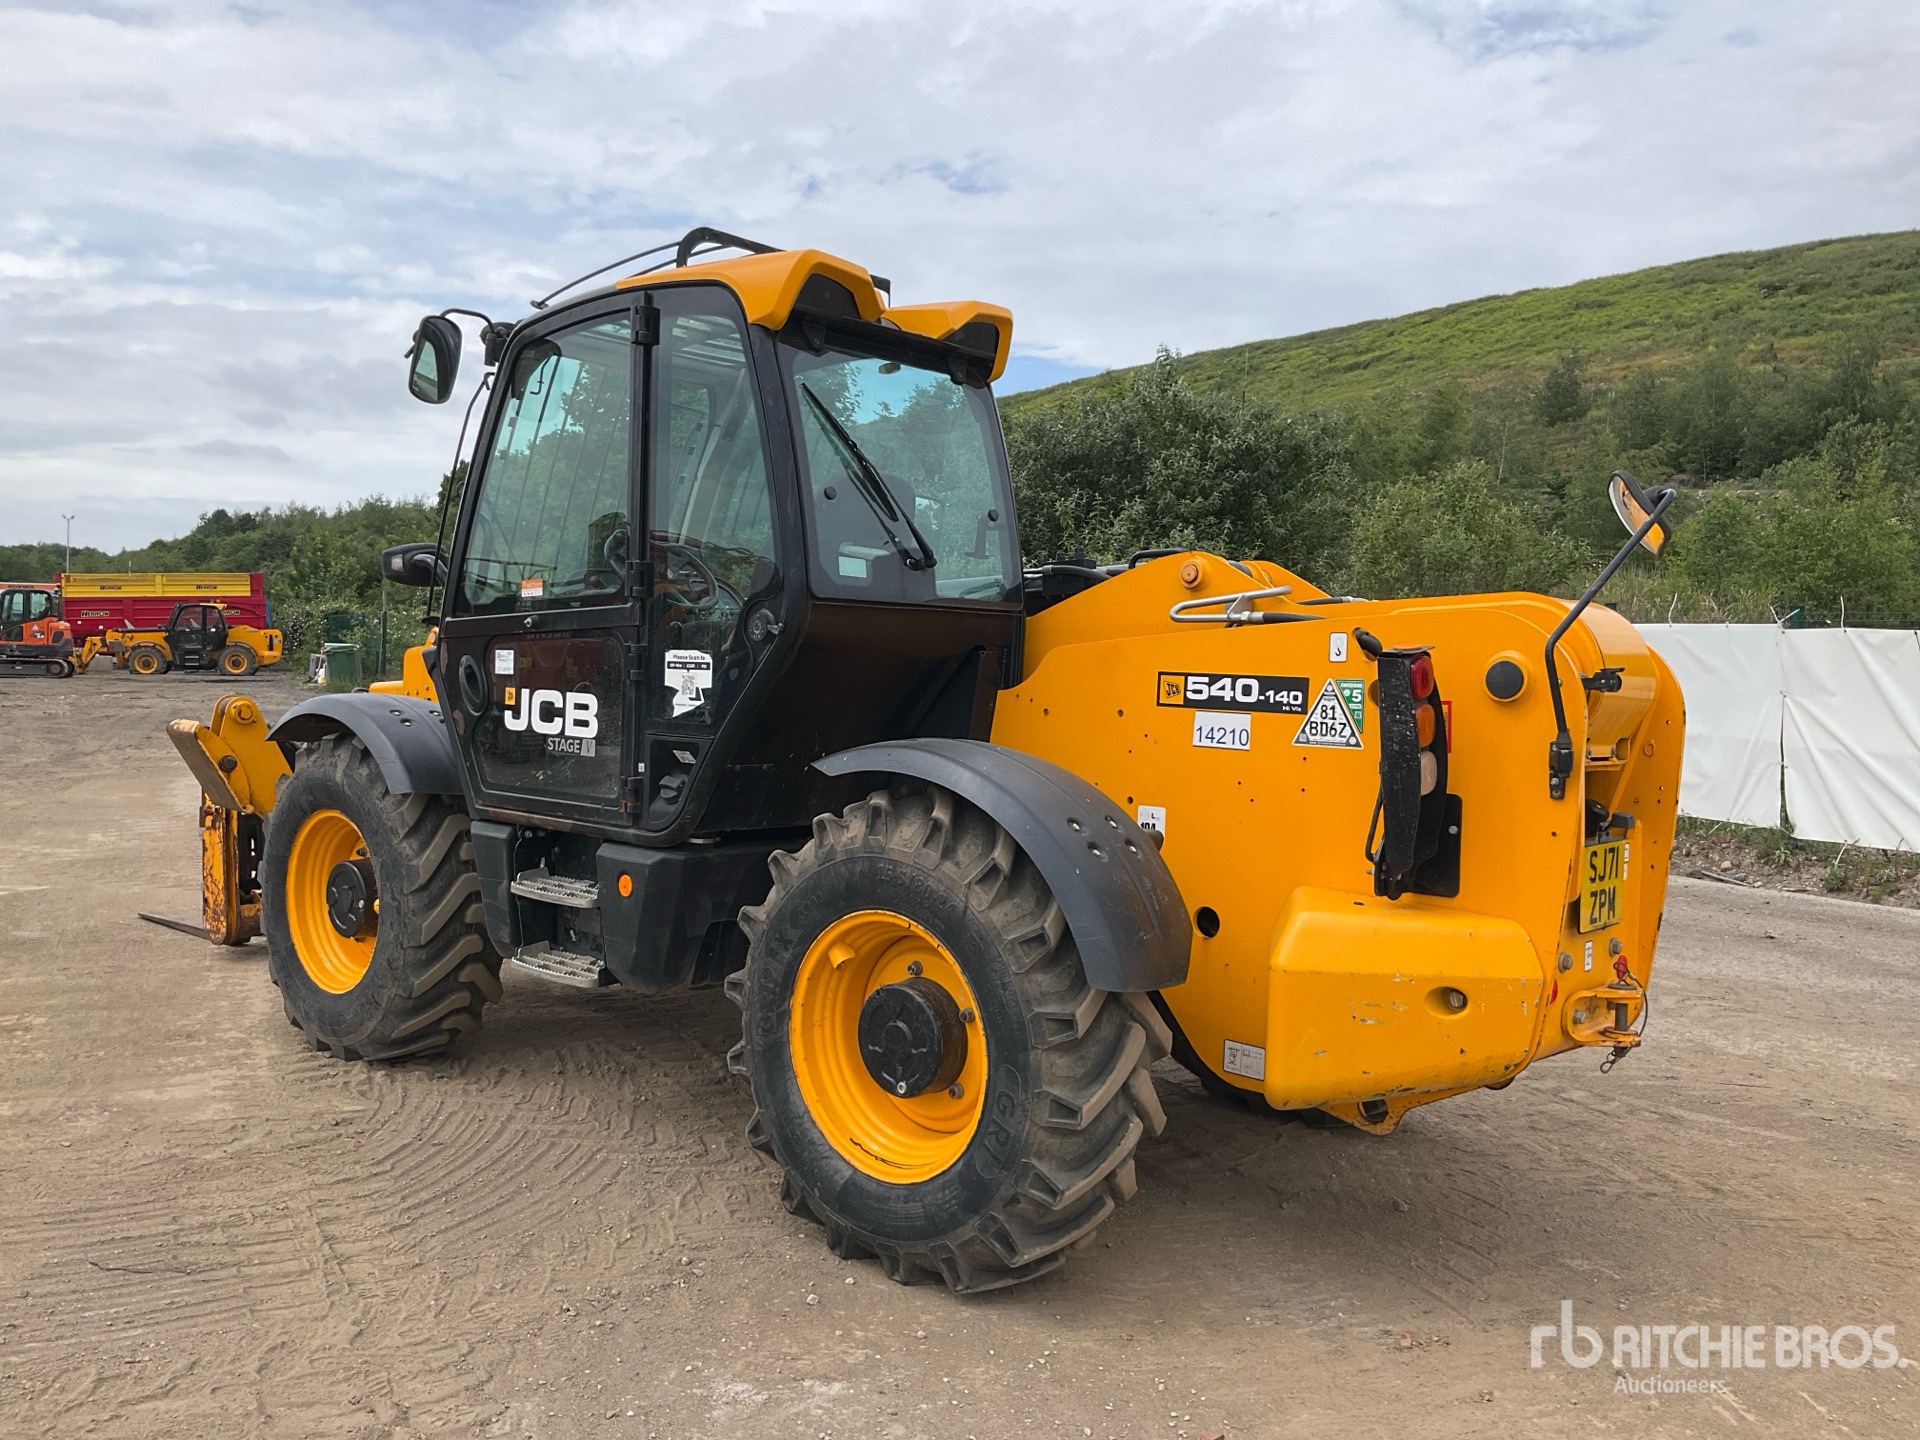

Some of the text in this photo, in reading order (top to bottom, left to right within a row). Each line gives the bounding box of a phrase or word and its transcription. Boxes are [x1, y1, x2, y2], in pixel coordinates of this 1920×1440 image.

[1165, 682, 1180, 697] JCB
[1186, 676, 1303, 705] 540-140
[1351, 689, 1362, 702] 5
[504, 687, 599, 739] JCB
[1320, 704, 1337, 721] 81
[547, 737, 581, 754] STAGE
[1195, 725, 1250, 747] 14210
[1589, 845, 1620, 884] SJ71
[1589, 886, 1616, 925] ZPM
